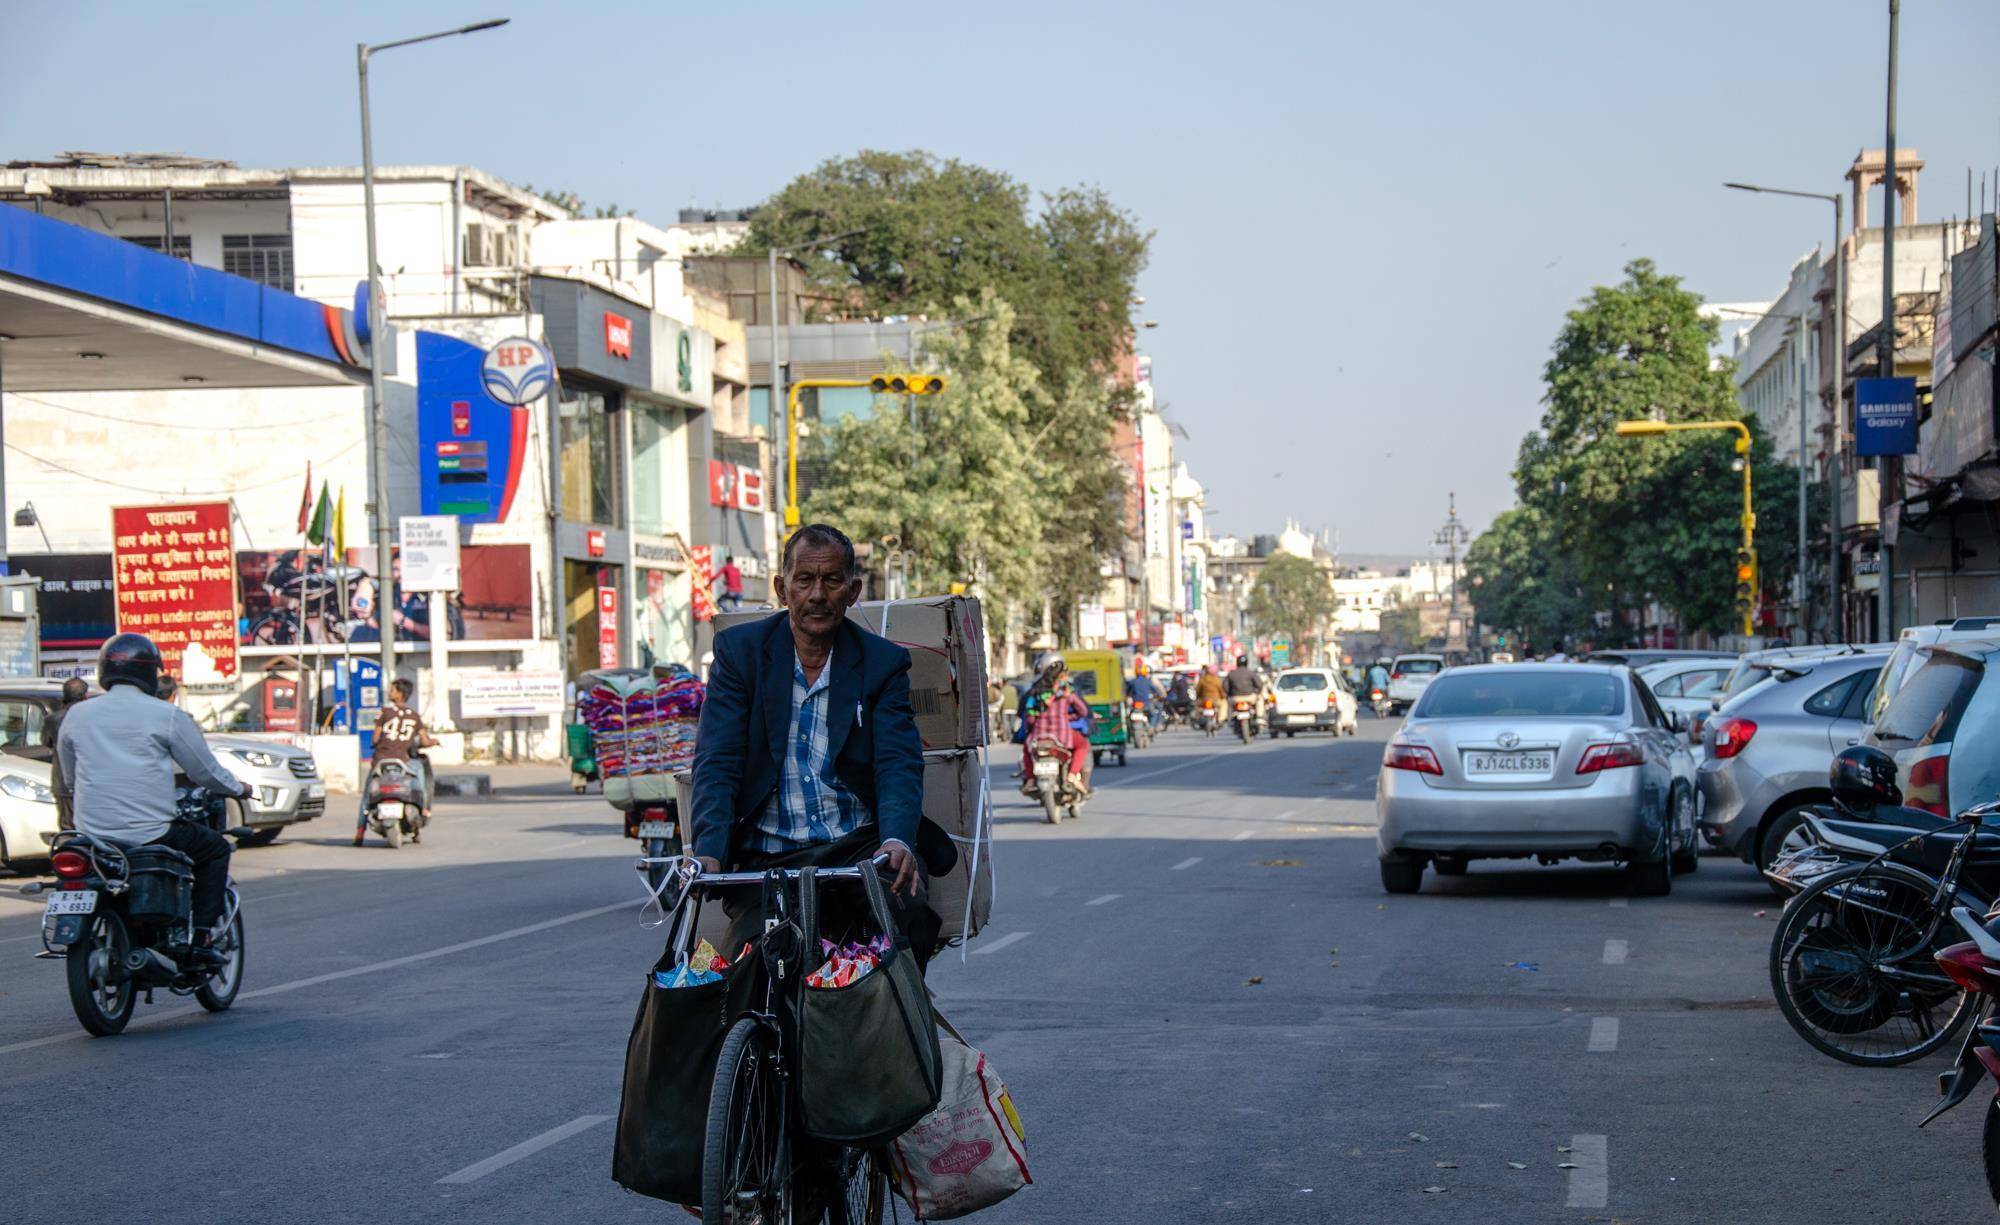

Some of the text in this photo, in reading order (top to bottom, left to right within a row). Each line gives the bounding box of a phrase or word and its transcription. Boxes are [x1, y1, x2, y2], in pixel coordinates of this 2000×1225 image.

[497, 346, 534, 367] HP
[1860, 403, 1913, 414] SAMSUNG
[1866, 417, 1906, 429] Galaxy
[146, 510, 197, 526] सावधान
[117, 535, 137, 549] आप
[139, 531, 162, 547] कैमरे
[165, 530, 179, 545] की
[118, 553, 148, 571] कृपया
[152, 549, 192, 569] असुविधा
[194, 546, 205, 563] से
[119, 570, 130, 585] के
[157, 569, 200, 583] यातायात
[120, 590, 135, 603] का
[136, 588, 167, 602] पालन
[120, 609, 233, 626] You are under camera
[190, 628, 203, 641] to
[203, 625, 234, 641] avoid
[361, 666, 379, 680] Air
[383, 716, 416, 742] 45
[1476, 756, 1550, 771] RJ14CL6336
[69, 902, 93, 912] 6933
